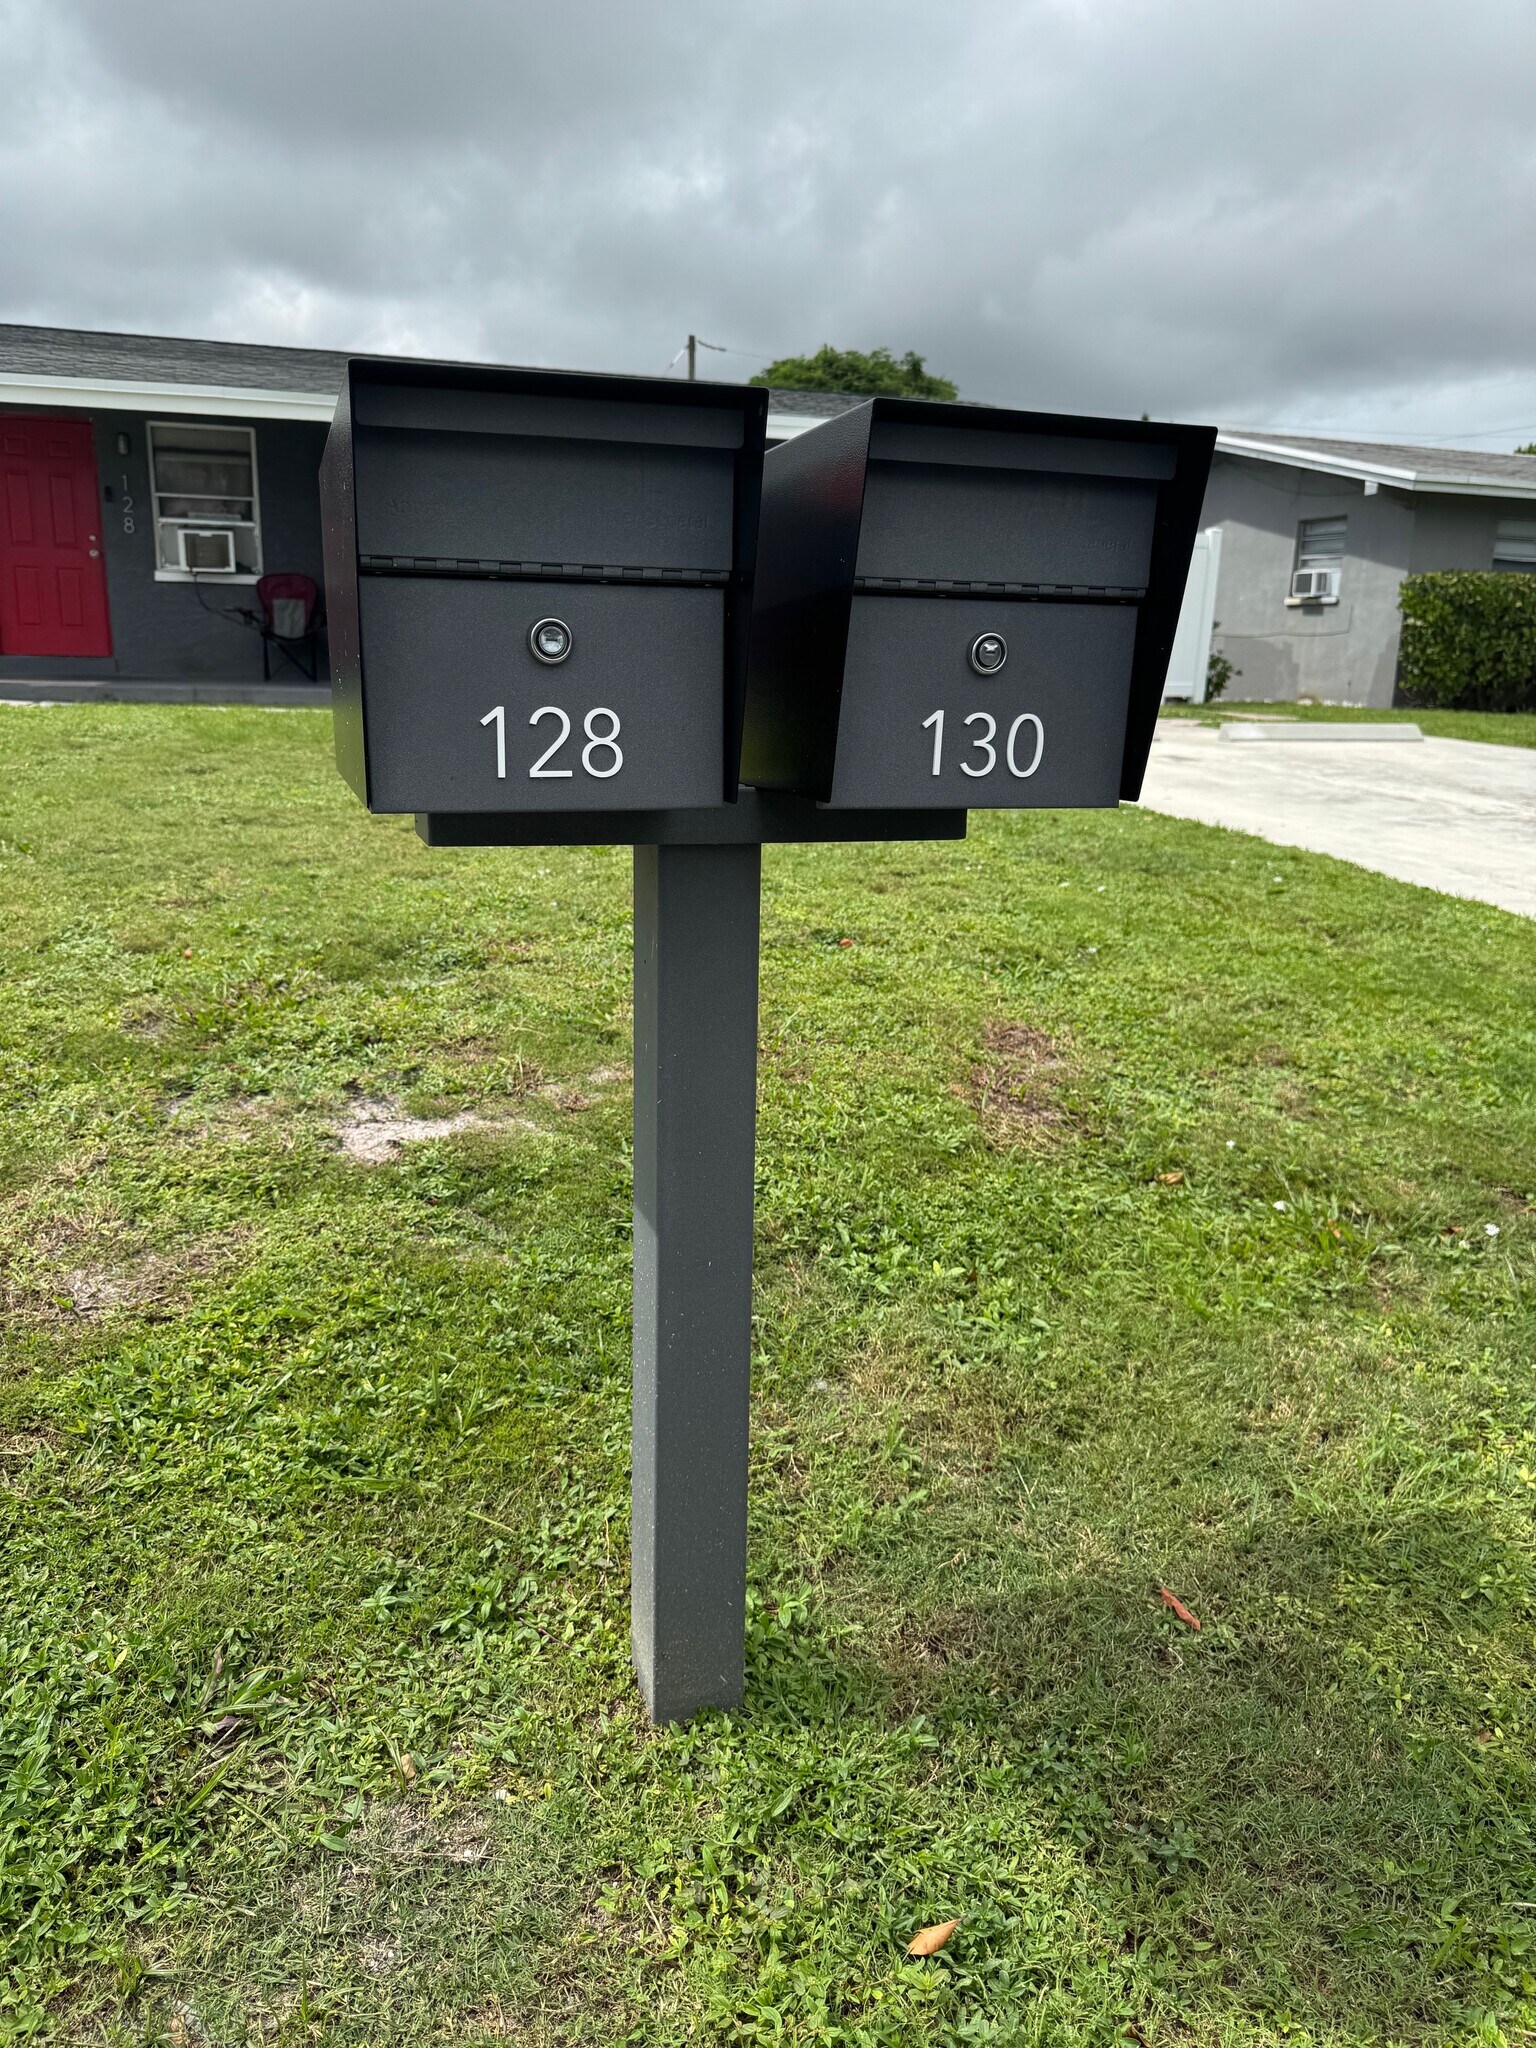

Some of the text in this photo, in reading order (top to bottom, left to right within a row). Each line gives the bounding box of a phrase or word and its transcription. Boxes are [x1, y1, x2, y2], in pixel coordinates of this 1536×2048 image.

[122, 474, 135, 534] 128
[479, 705, 624, 779] 128
[921, 709, 1045, 779] 130
